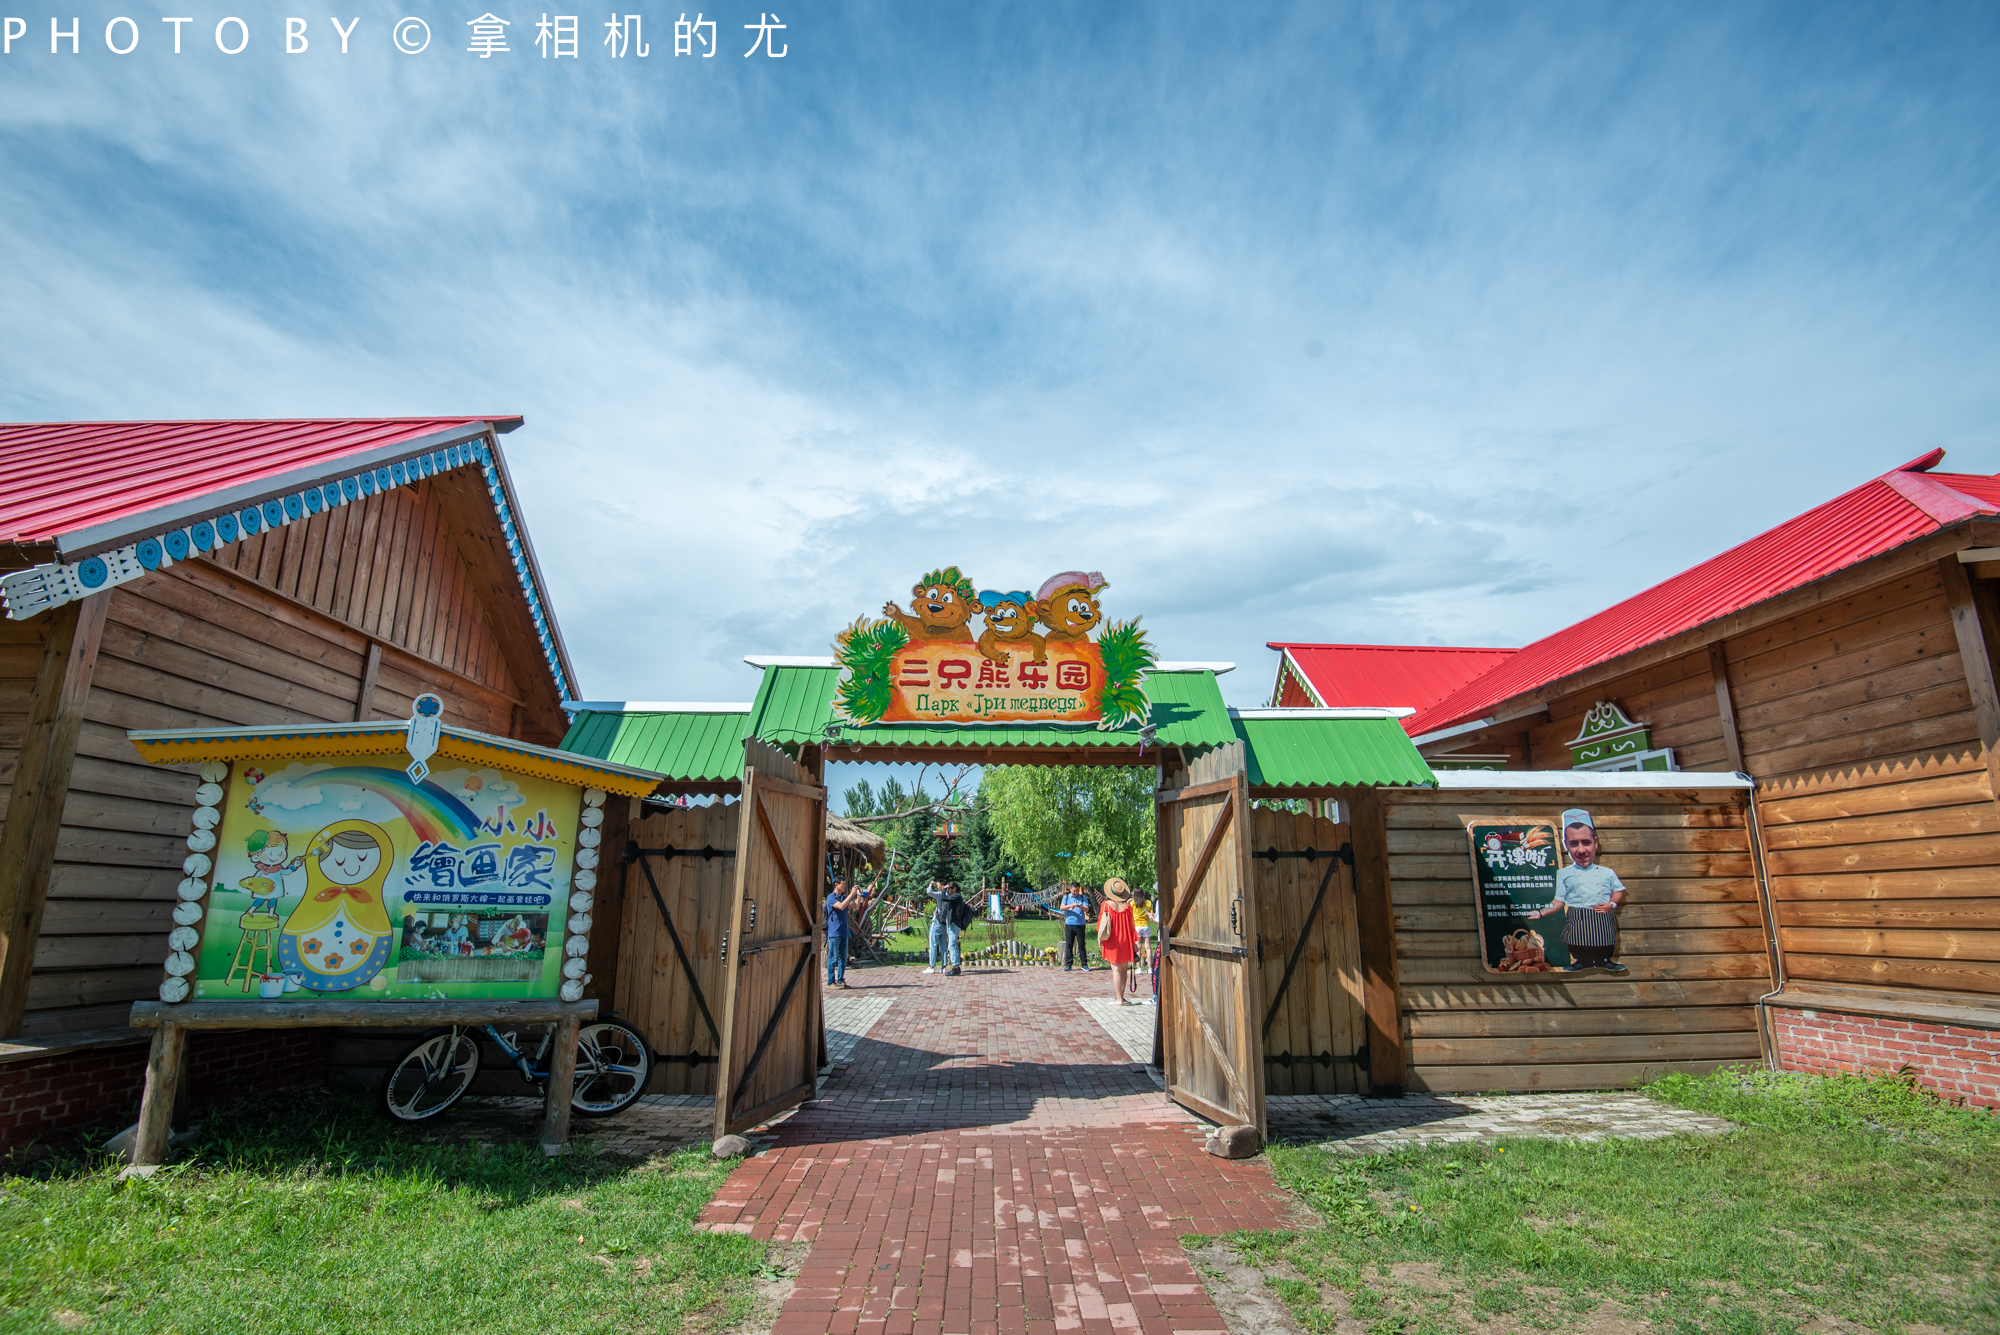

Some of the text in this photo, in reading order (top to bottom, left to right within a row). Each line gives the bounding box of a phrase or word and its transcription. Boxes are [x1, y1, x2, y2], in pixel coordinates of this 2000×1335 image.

[898, 657, 1092, 690] 三只熊乐园
[915, 693, 960, 716] Парк
[480, 805, 558, 842] 小小
[1485, 847, 1547, 868] 开课啦
